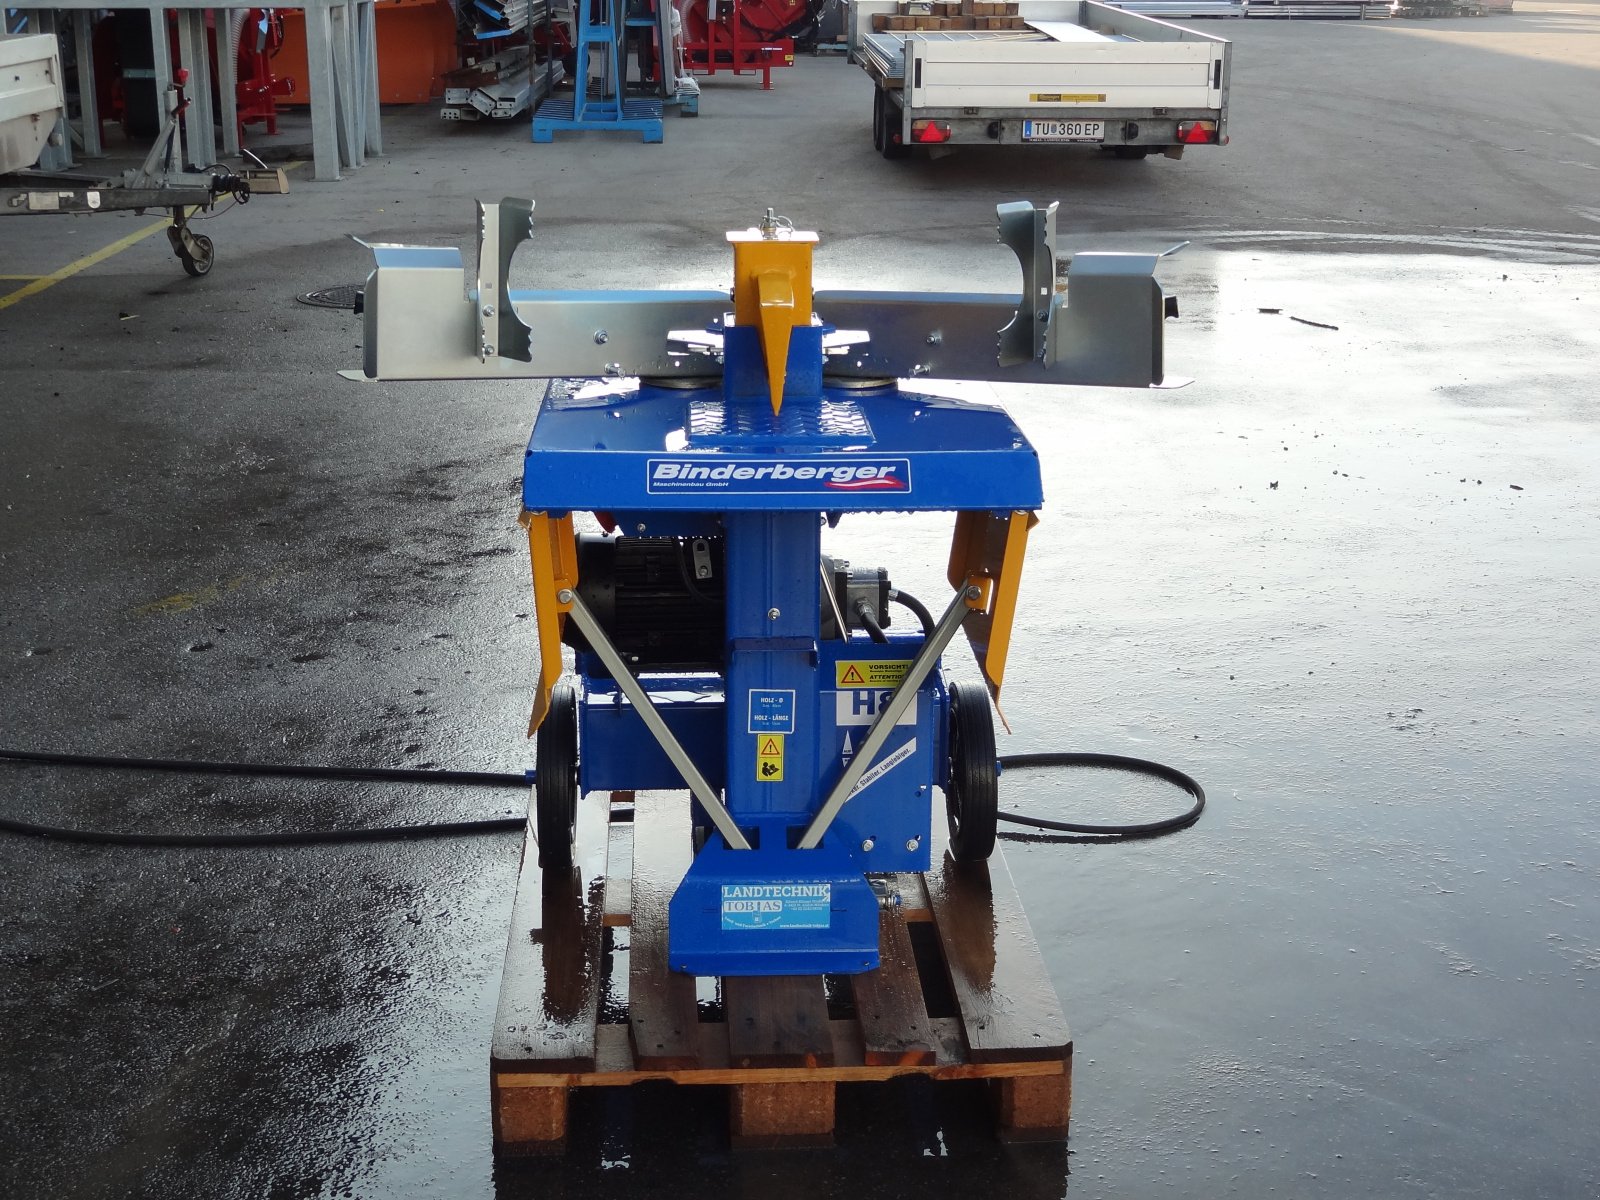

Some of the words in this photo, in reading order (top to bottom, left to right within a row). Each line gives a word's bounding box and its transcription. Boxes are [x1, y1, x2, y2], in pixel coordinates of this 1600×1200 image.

[1035, 123, 1049, 135] TU
[1059, 123, 1081, 135] 360
[1085, 123, 1099, 135] EP
[653, 463, 897, 482] Binderberger
[723, 885, 829, 898] LANDTECHNIK
[725, 901, 781, 911] TOBIAS
